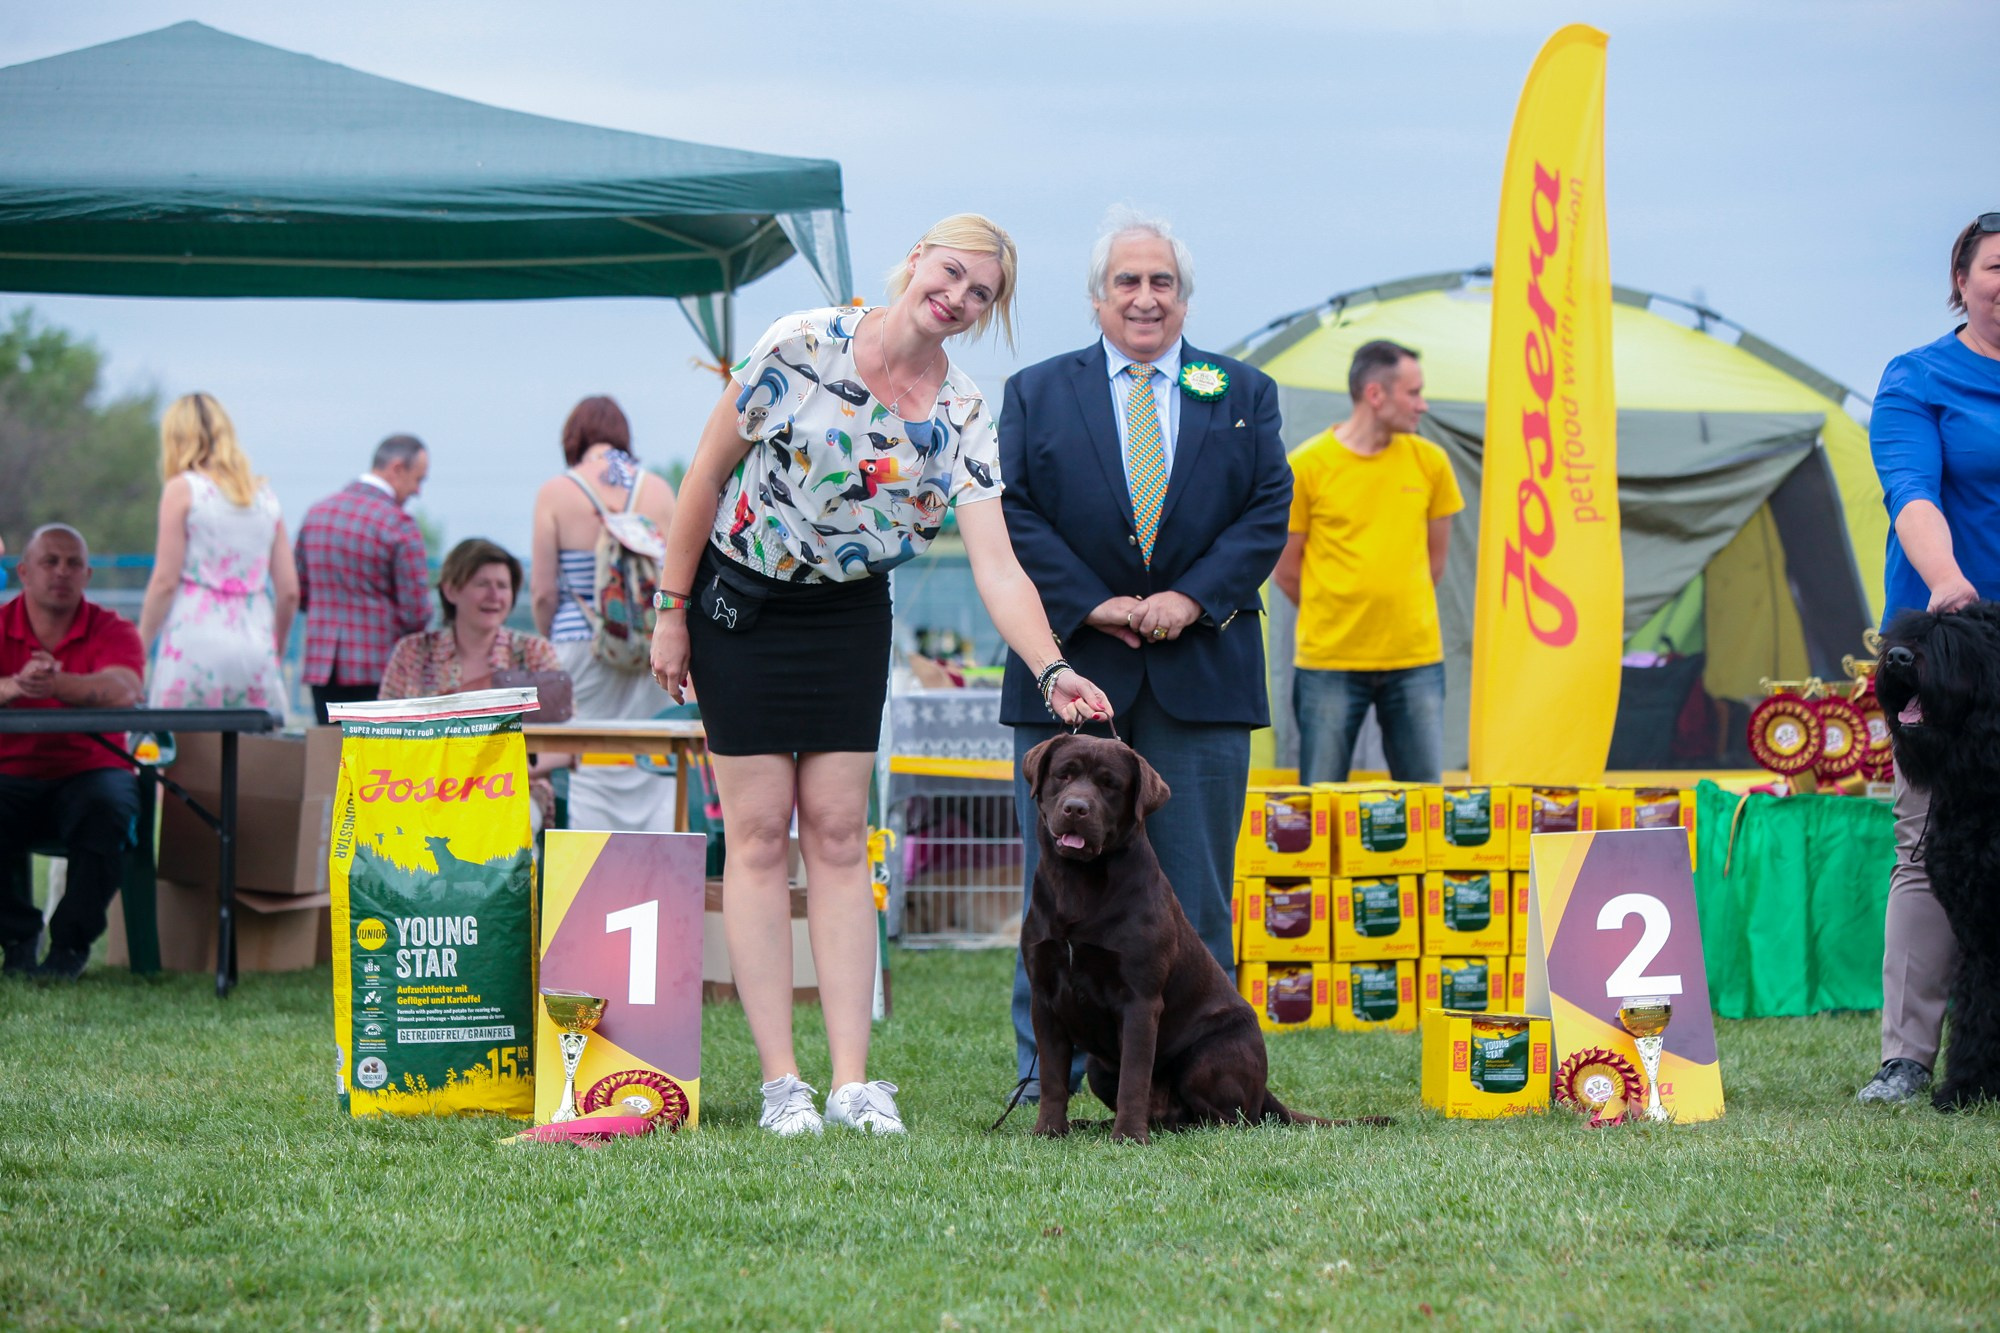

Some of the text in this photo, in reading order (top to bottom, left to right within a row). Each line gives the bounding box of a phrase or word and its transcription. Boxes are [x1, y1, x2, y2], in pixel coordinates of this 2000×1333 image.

[1502, 159, 1578, 648] Josera
[1560, 395, 1606, 523] petfood
[349, 726, 370, 735] SUPER
[372, 727, 402, 735] PREMIUM
[404, 728, 416, 737] PET
[418, 728, 434, 737] FOOD
[463, 725, 471, 733] IN
[471, 723, 502, 733] GERMANY
[359, 769, 517, 804] Josera
[334, 793, 356, 859] OUNGSTAR
[357, 928, 388, 940] JUNIOR
[395, 915, 478, 947] YOUNG
[1596, 892, 1683, 998] 2
[396, 948, 458, 979] STAR
[605, 899, 659, 1005] 1
[397, 984, 468, 994] Aufzuchtfutter mit
[397, 995, 481, 1006] Geflügel und Kartoffel
[468, 1027, 511, 1039] GRAINFREE
[1484, 1040, 1509, 1051] YOUNG
[487, 1046, 529, 1082] 15 KG
[1485, 1049, 1504, 1059] STAR
